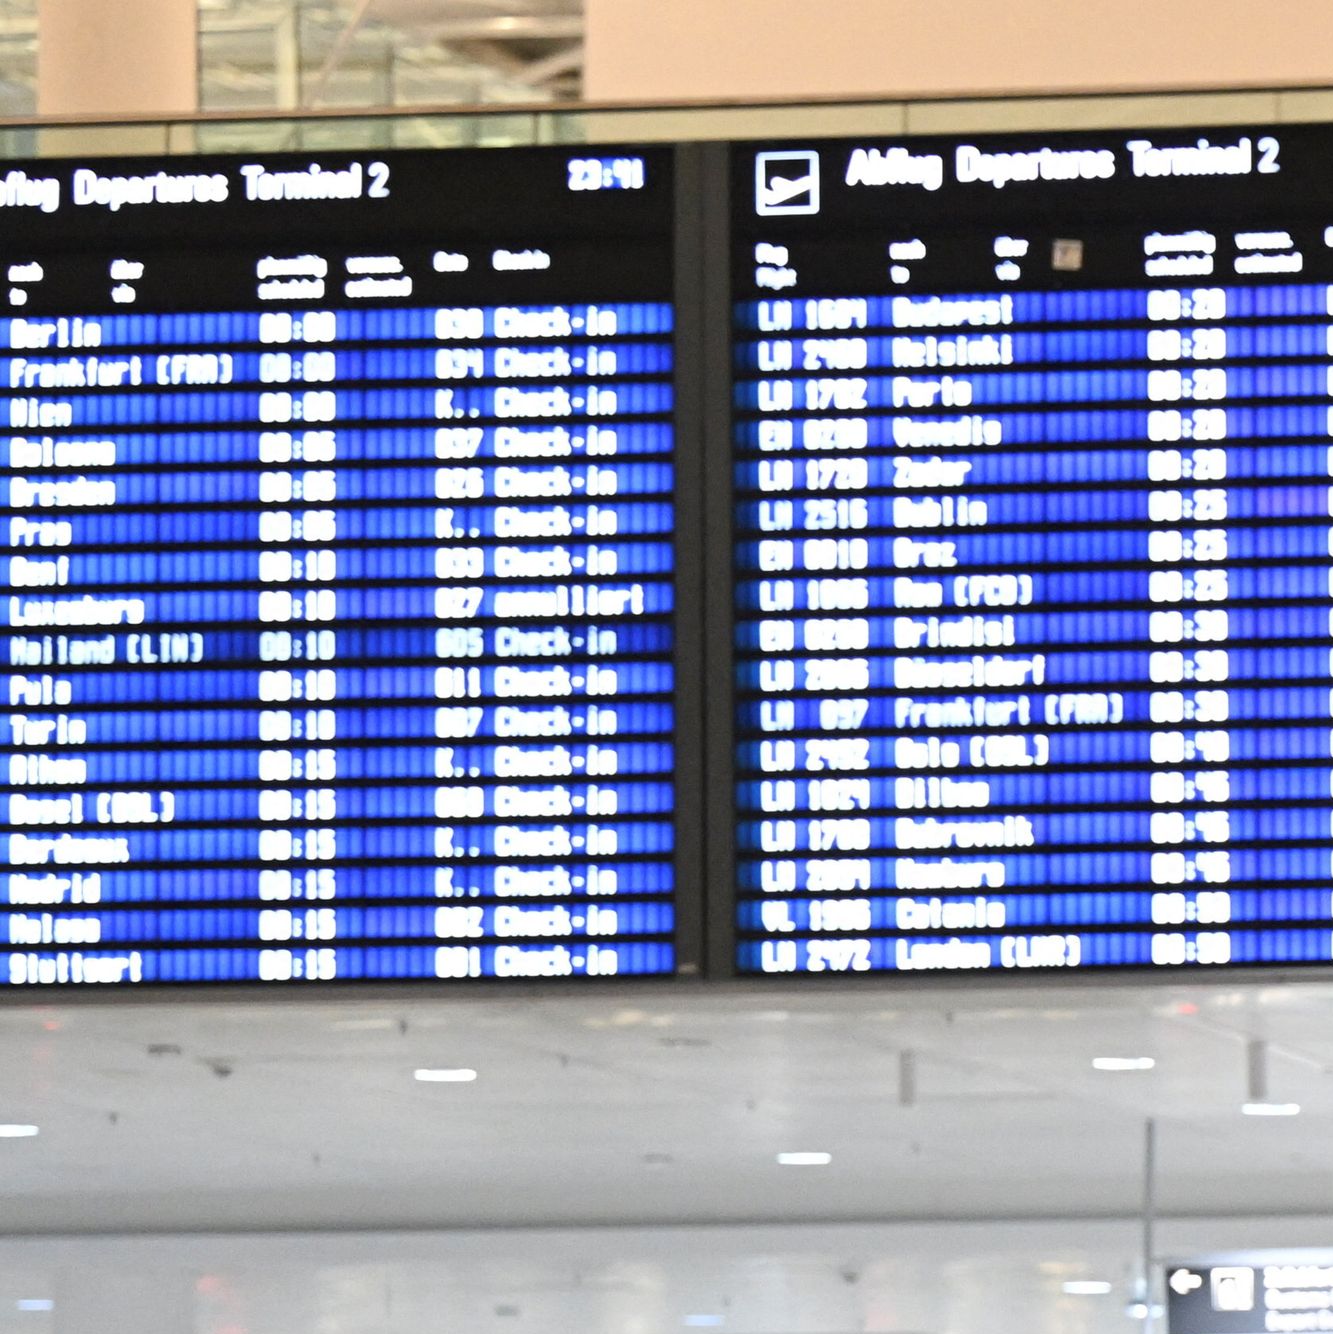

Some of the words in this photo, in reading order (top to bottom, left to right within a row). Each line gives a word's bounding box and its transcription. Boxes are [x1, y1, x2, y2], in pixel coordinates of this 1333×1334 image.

[74, 170, 228, 211] Departures
[241, 163, 362, 200] Terminal
[369, 162, 389, 197] 2
[569, 159, 643, 190] 23:41
[846, 148, 942, 190] Abflug
[956, 146, 1115, 188] Departures
[1127, 138, 1251, 176] Terminal
[1258, 138, 1279, 173] 2
[495, 506, 617, 537] Check-in
[11, 636, 114, 665] Mailand
[496, 628, 616, 656] Check-in
